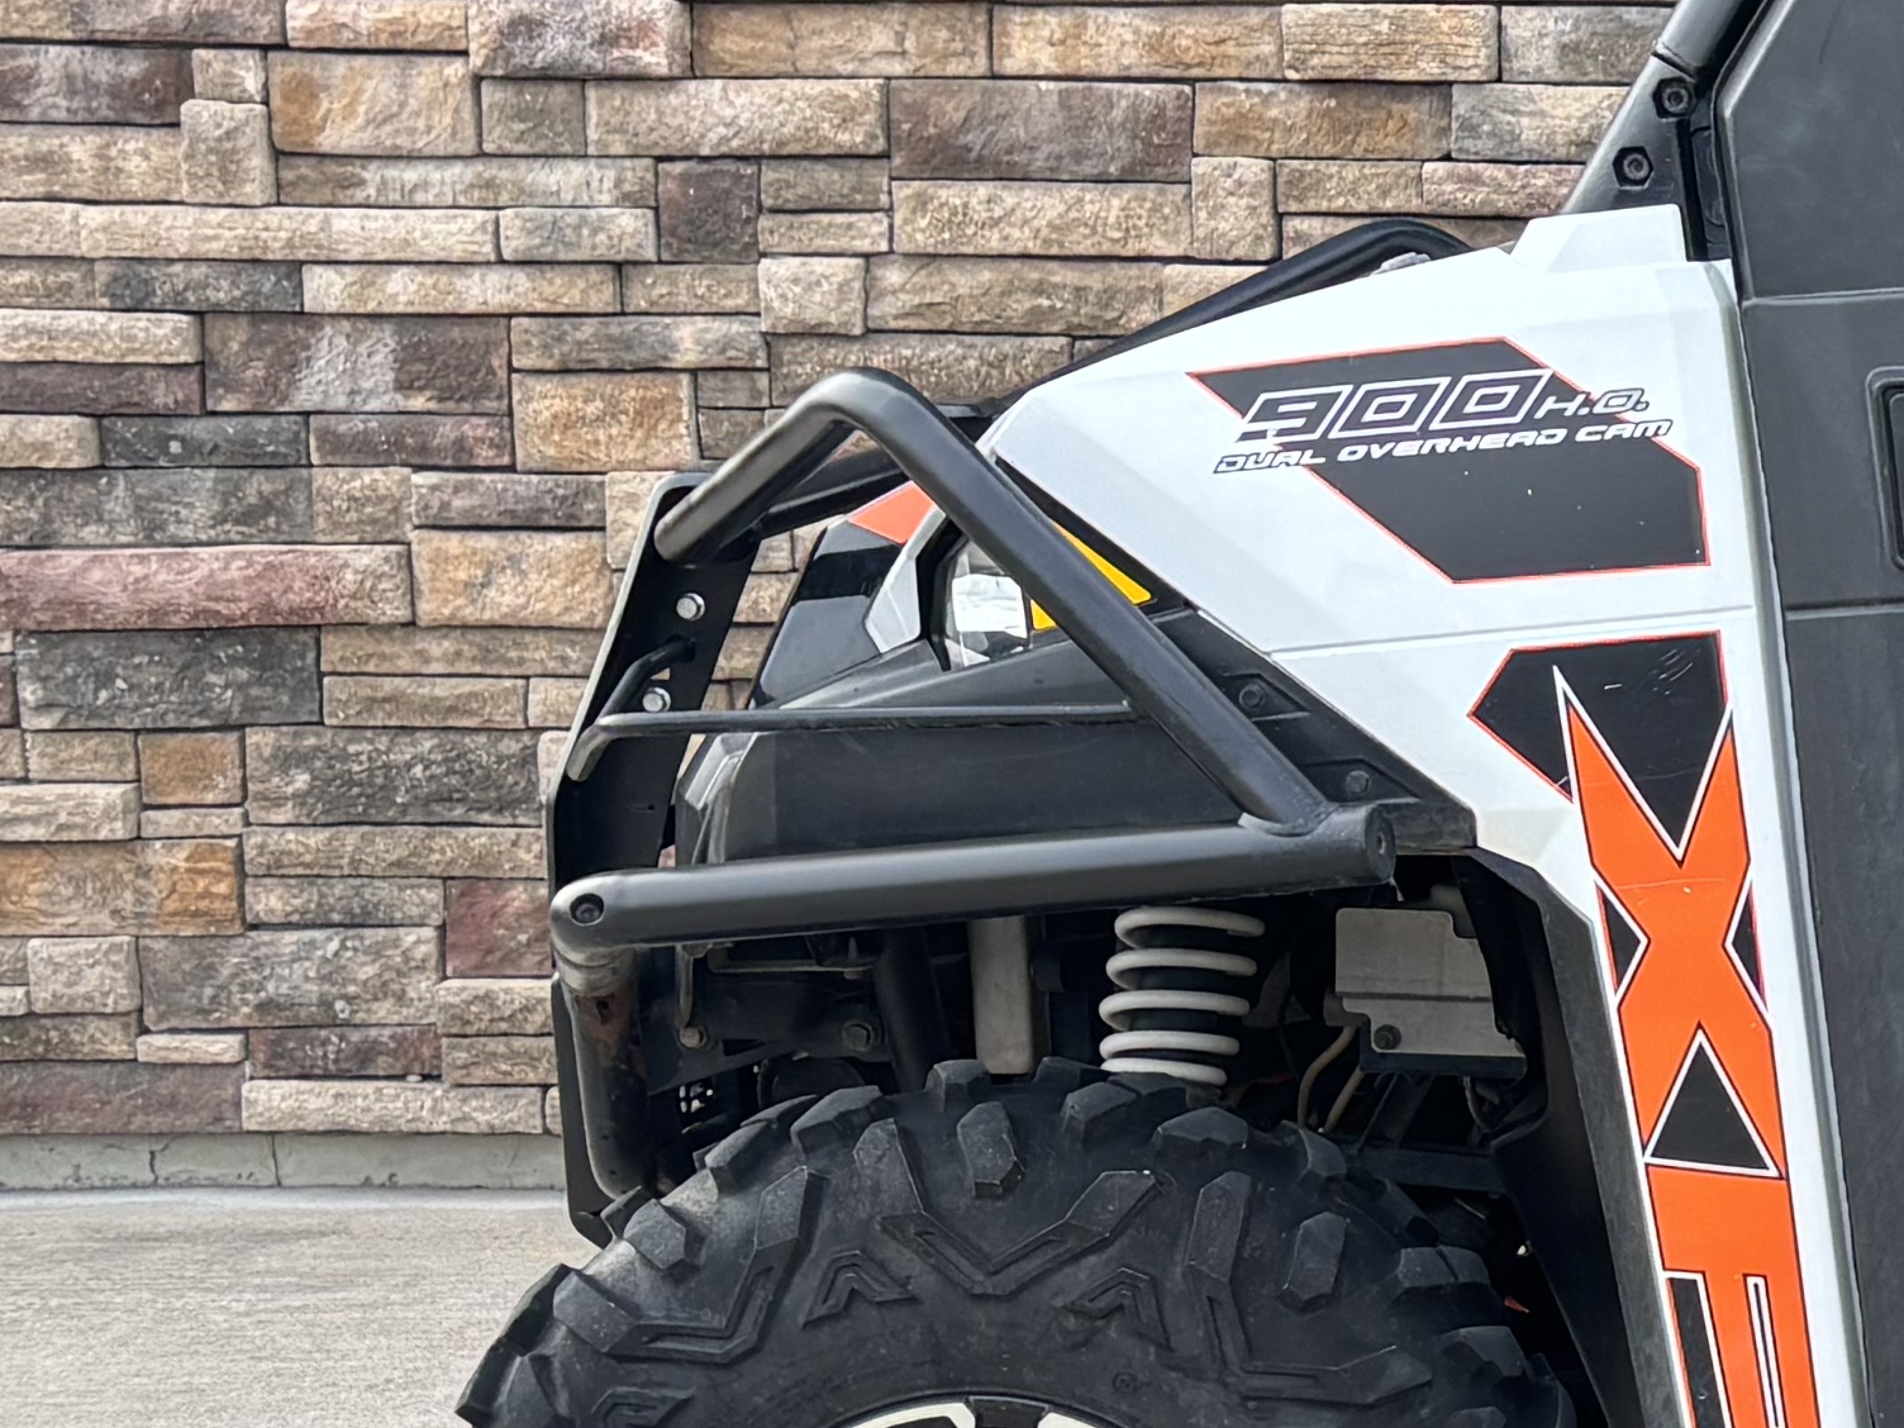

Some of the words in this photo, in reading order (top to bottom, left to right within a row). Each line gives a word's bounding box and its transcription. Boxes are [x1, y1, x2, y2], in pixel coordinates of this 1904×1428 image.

[1236, 368, 1556, 444] 900
[1533, 387, 1651, 420] H.O.
[1212, 448, 1327, 474] DUAL
[1336, 426, 1568, 463] OVERHEAD
[1574, 418, 1674, 441] CAM
